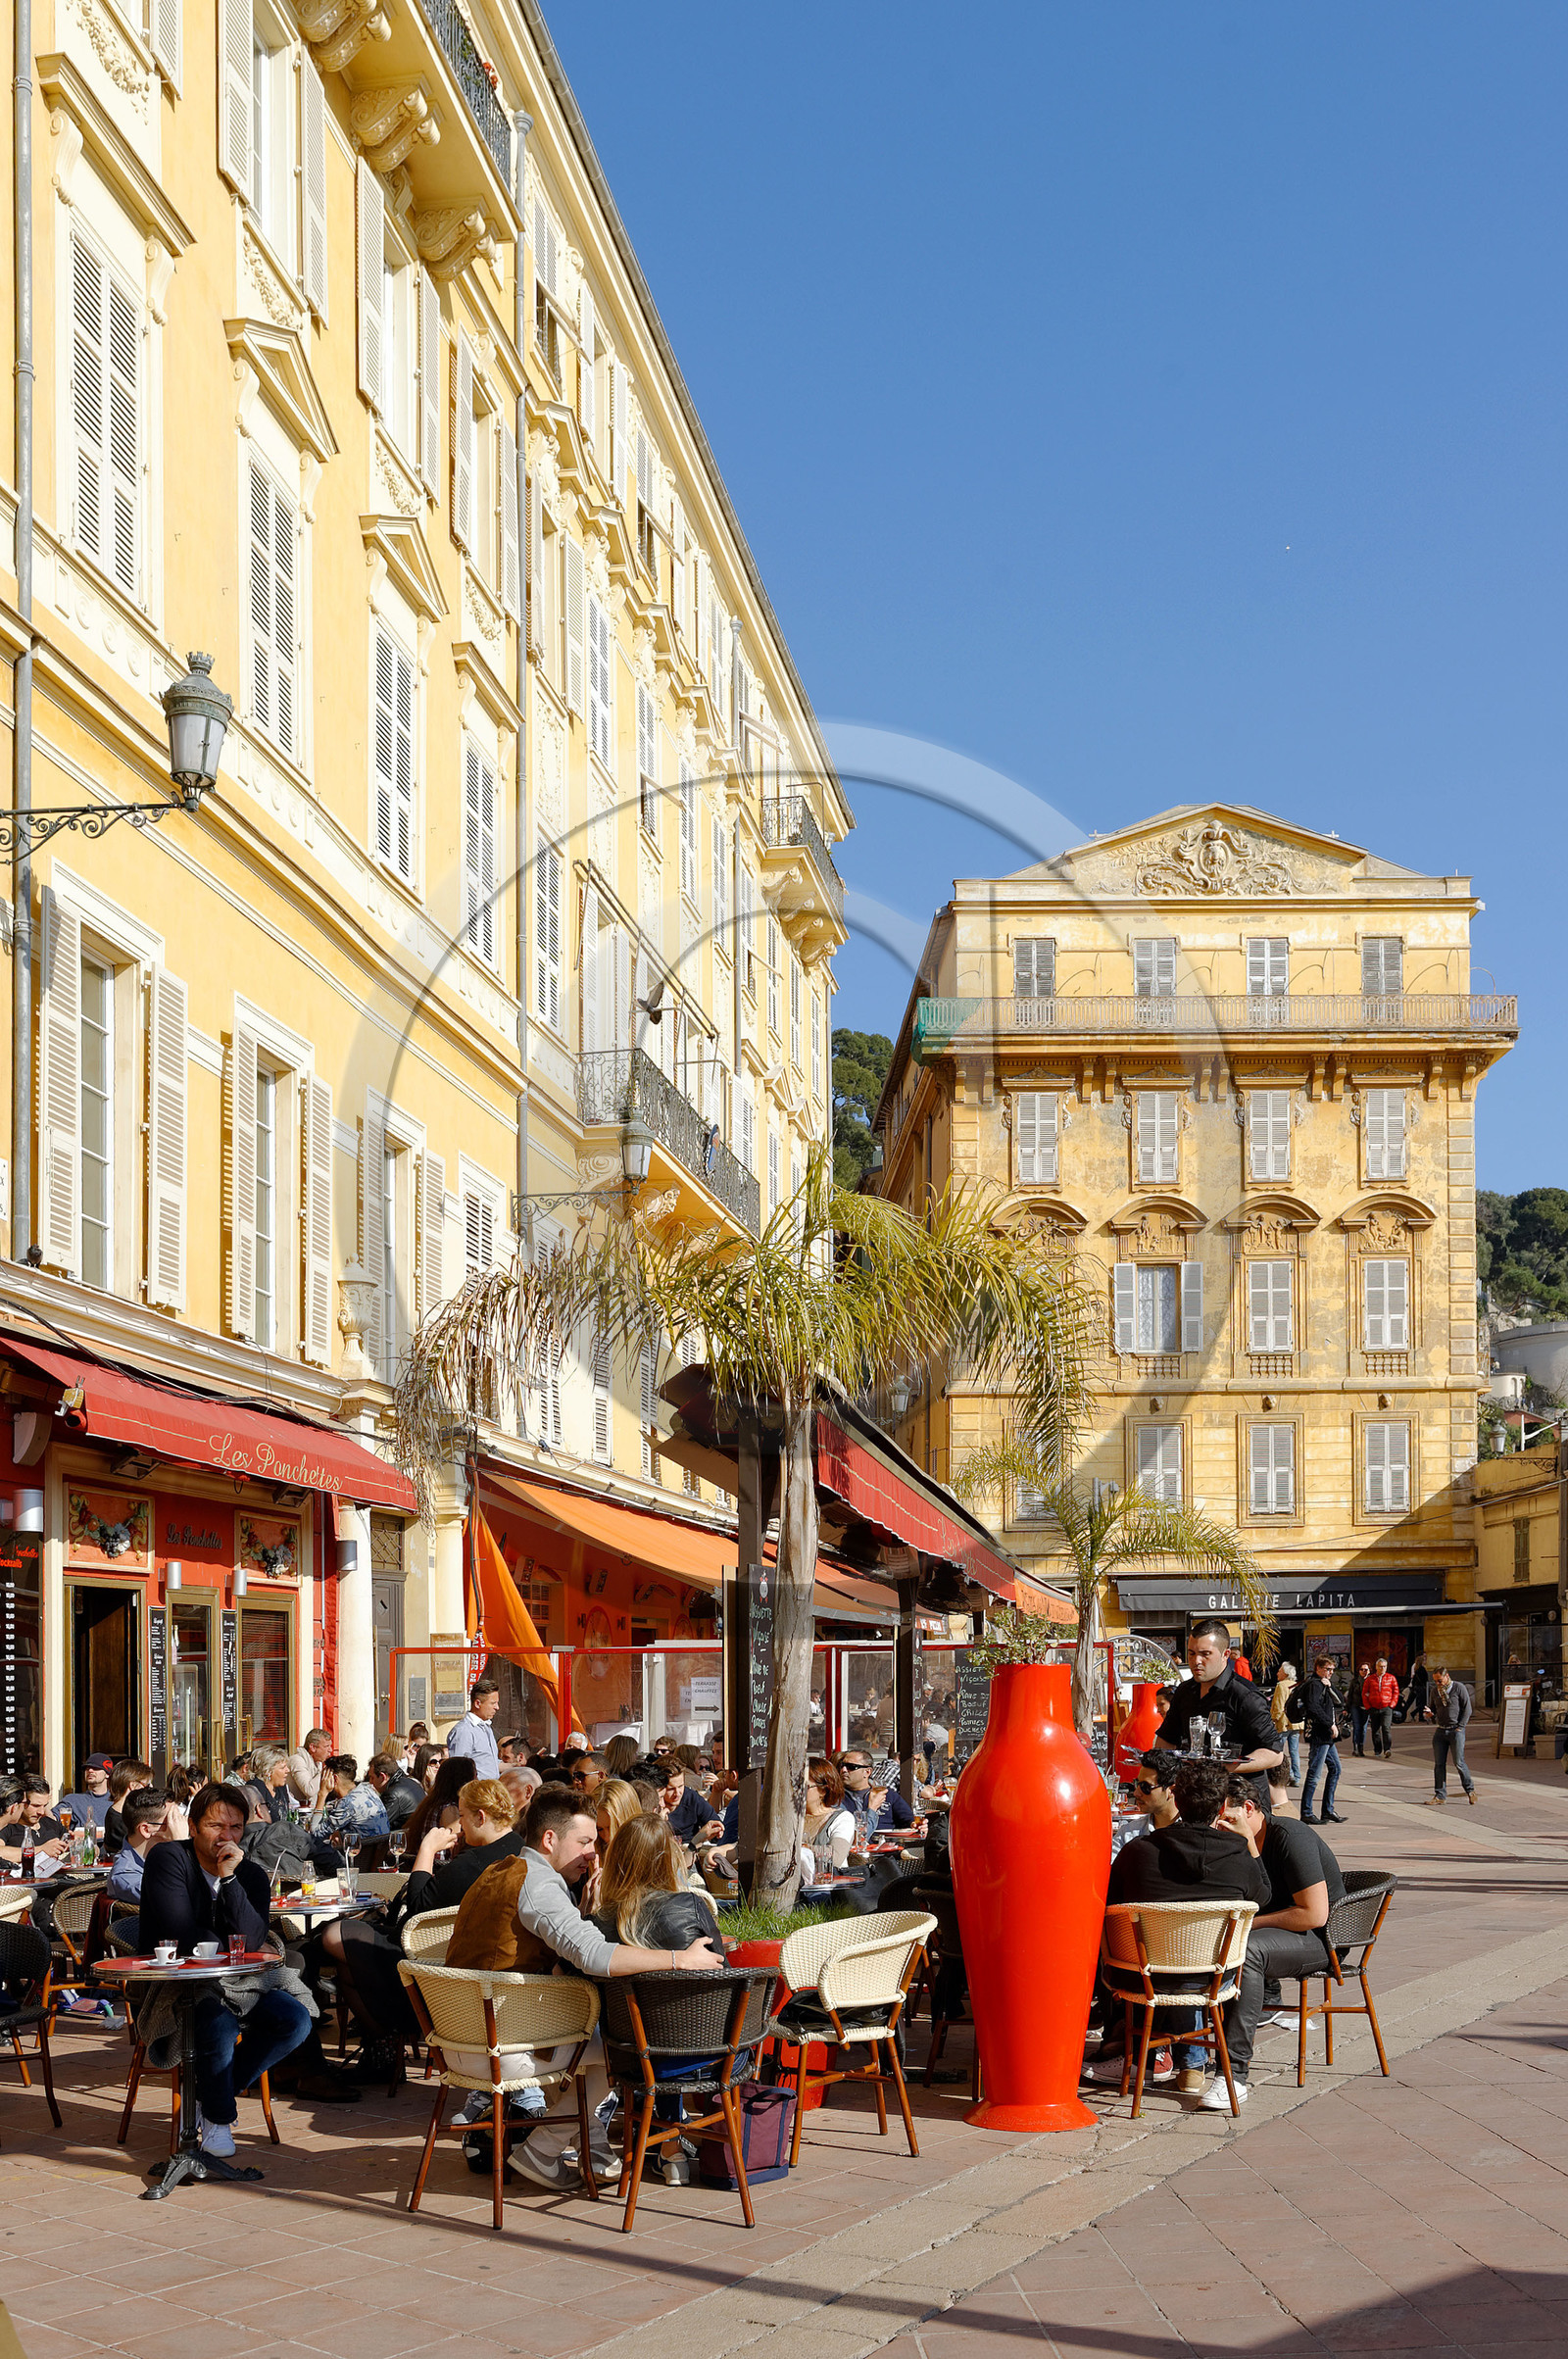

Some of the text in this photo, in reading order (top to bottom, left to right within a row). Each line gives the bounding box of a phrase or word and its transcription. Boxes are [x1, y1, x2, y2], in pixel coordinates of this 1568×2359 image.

[209, 1433, 343, 1491] Les Ponchettes
[1296, 1594, 1355, 1608] LAPITA
